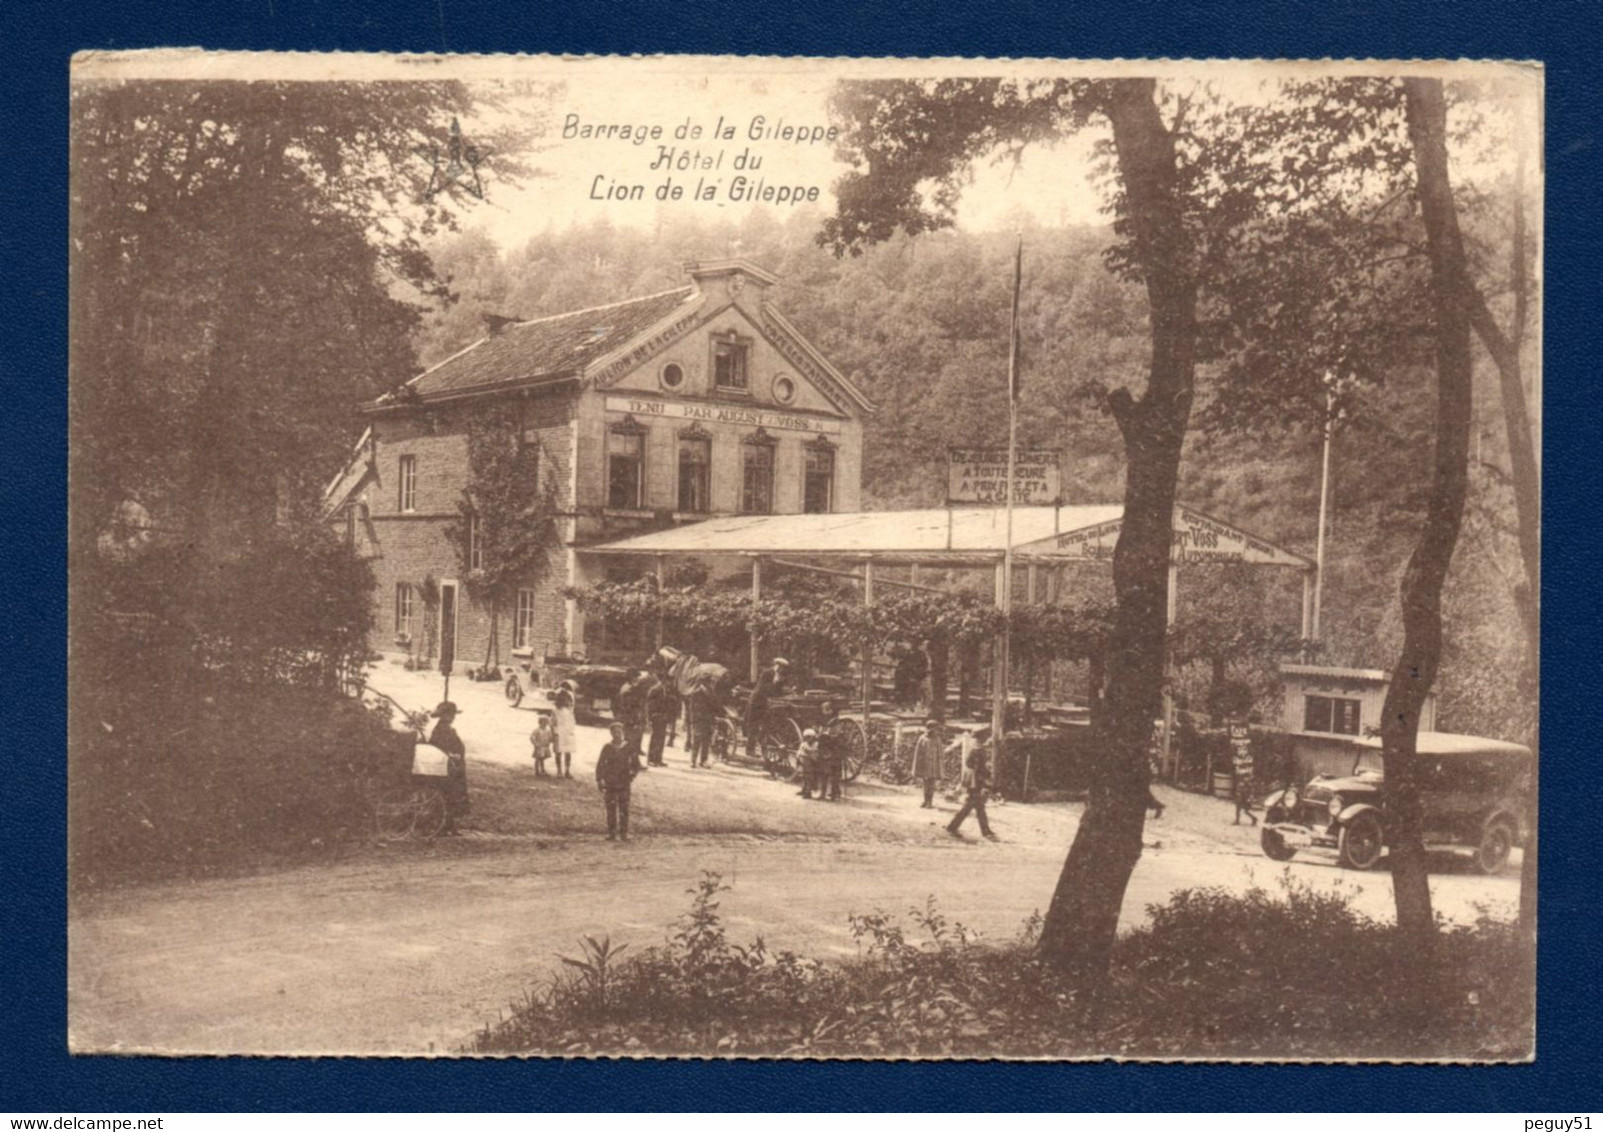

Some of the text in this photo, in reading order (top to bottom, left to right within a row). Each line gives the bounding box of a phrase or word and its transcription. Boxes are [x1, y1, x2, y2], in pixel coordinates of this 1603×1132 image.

[648, 336, 663, 351] LA
[628, 400, 665, 415] TENU
[683, 405, 712, 419] PAR
[776, 416, 809, 430] VOSS
[951, 451, 1010, 465] DEJEUNER
[999, 480, 1022, 493] FIE
